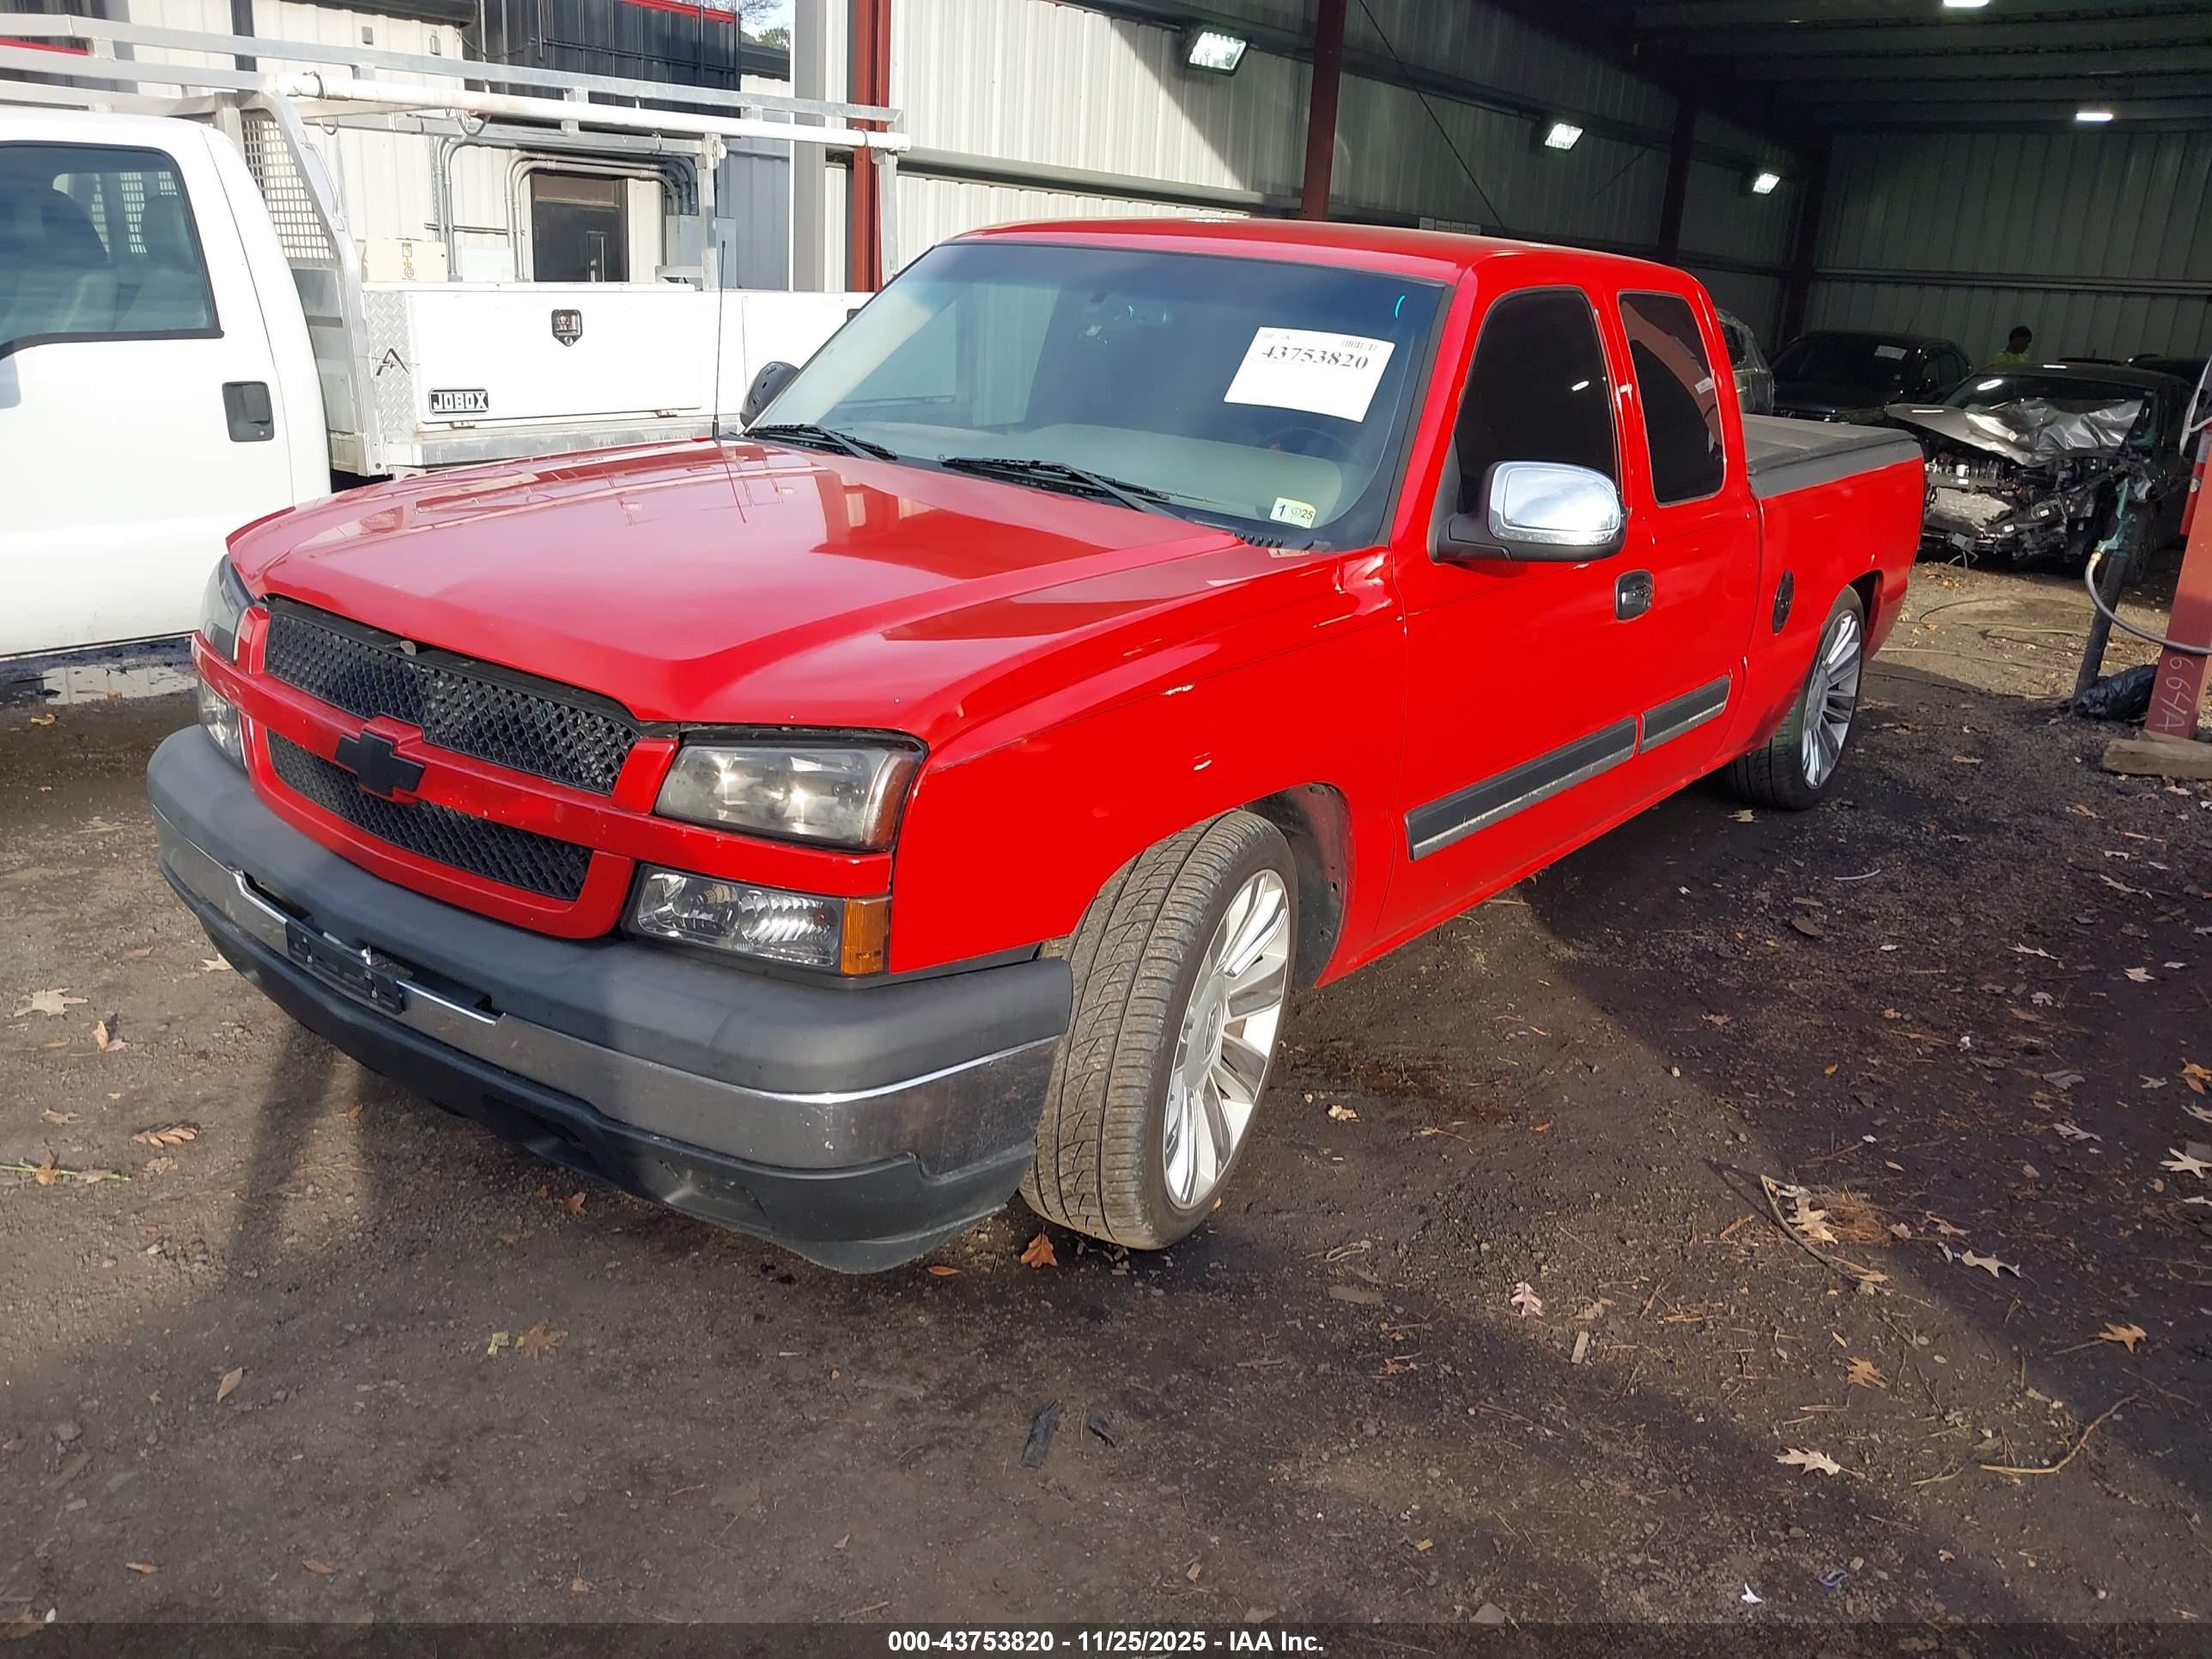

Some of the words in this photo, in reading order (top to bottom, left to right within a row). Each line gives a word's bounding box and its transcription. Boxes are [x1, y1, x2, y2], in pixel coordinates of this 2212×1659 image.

[1261, 345, 1370, 369] 43753820
[433, 392, 488, 410] JOBOX
[1278, 503, 1286, 517] 1
[1301, 508, 1315, 520] 25
